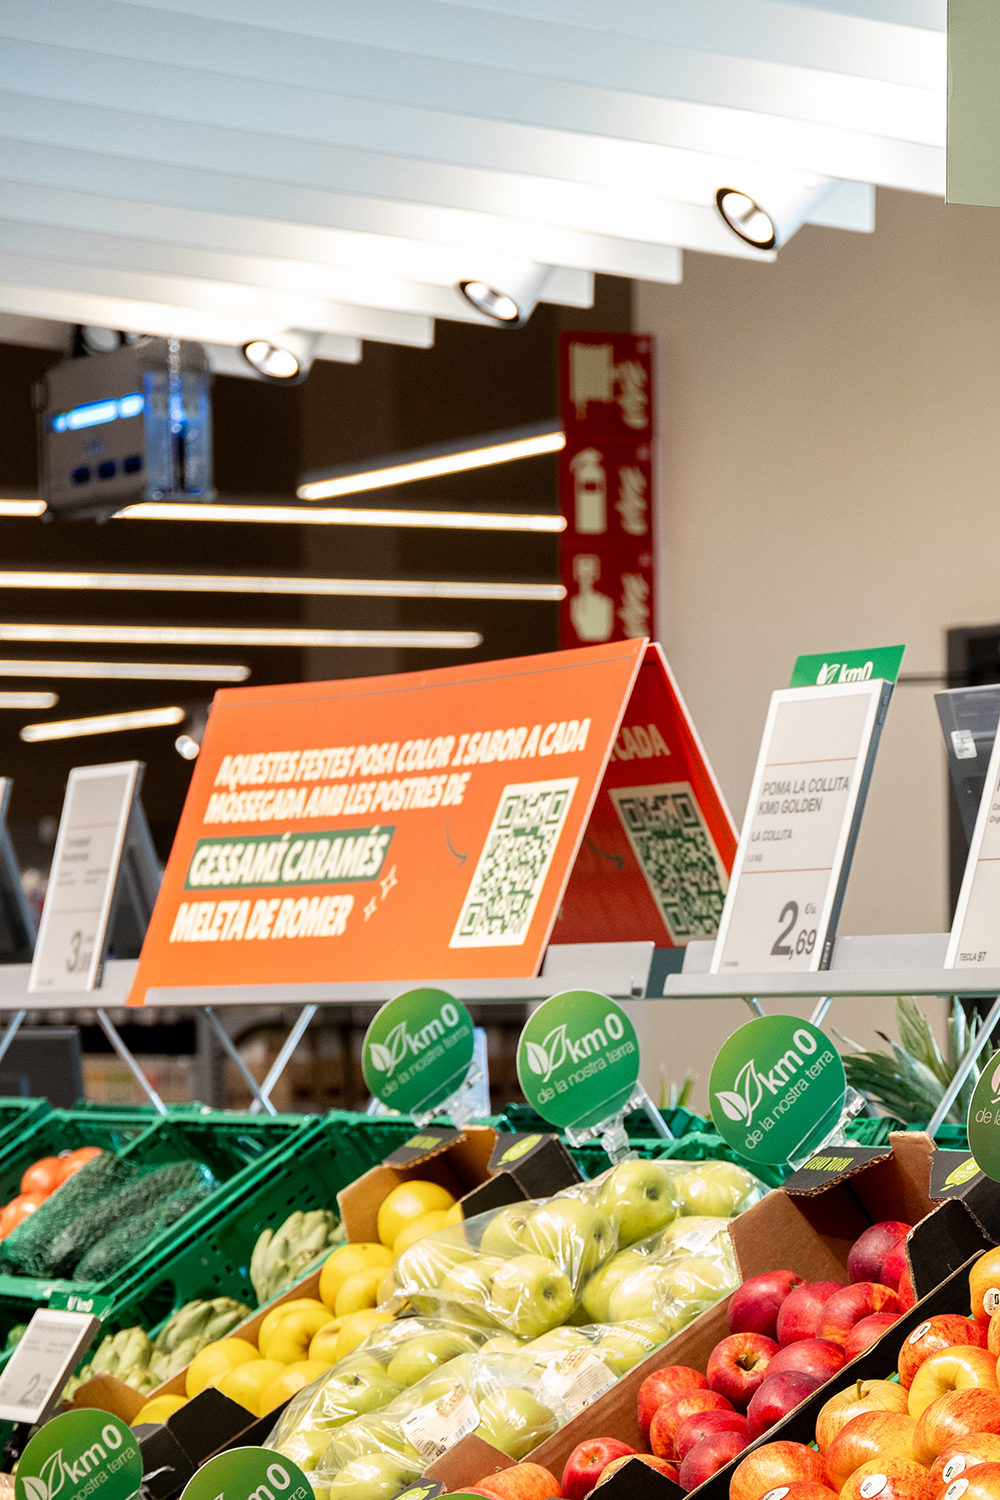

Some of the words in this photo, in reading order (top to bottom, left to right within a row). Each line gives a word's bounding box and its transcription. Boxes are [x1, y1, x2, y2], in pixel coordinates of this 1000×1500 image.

[837, 661, 873, 683] km0
[214, 750, 299, 791] AQUESTES
[294, 746, 355, 781] FESTES
[348, 742, 399, 777] POSA
[395, 735, 455, 772] COLOR
[451, 733, 470, 766] I
[462, 727, 528, 765] SABOR
[522, 724, 542, 758] A
[538, 717, 591, 757] CADA
[203, 787, 307, 824] MOSSEGADA
[302, 783, 349, 818] AMB
[342, 781, 377, 815] LES
[369, 774, 448, 813] POSTRES
[440, 772, 471, 806] DE
[762, 779, 791, 796] POMA
[793, 778, 805, 794] LA
[808, 776, 849, 793] COLLITA
[781, 798, 823, 814] GOLDEN
[281, 824, 391, 882] CARAMÉS
[169, 899, 251, 943] MELETA
[245, 898, 280, 940] DE
[271, 895, 355, 939] ROMER
[770, 900, 817, 960] 2,69
[959, 952, 977, 962] TECLA
[977, 952, 987, 962] 97
[565, 1028, 608, 1064] km
[604, 1013, 624, 1040] 0
[757, 1050, 804, 1095] km
[793, 1029, 817, 1055] 0
[745, 1129, 763, 1149] de
[759, 1116, 776, 1132] la
[772, 1078, 810, 1119] nostra
[804, 1050, 834, 1080] terra
[266, 1463, 291, 1490] 0
